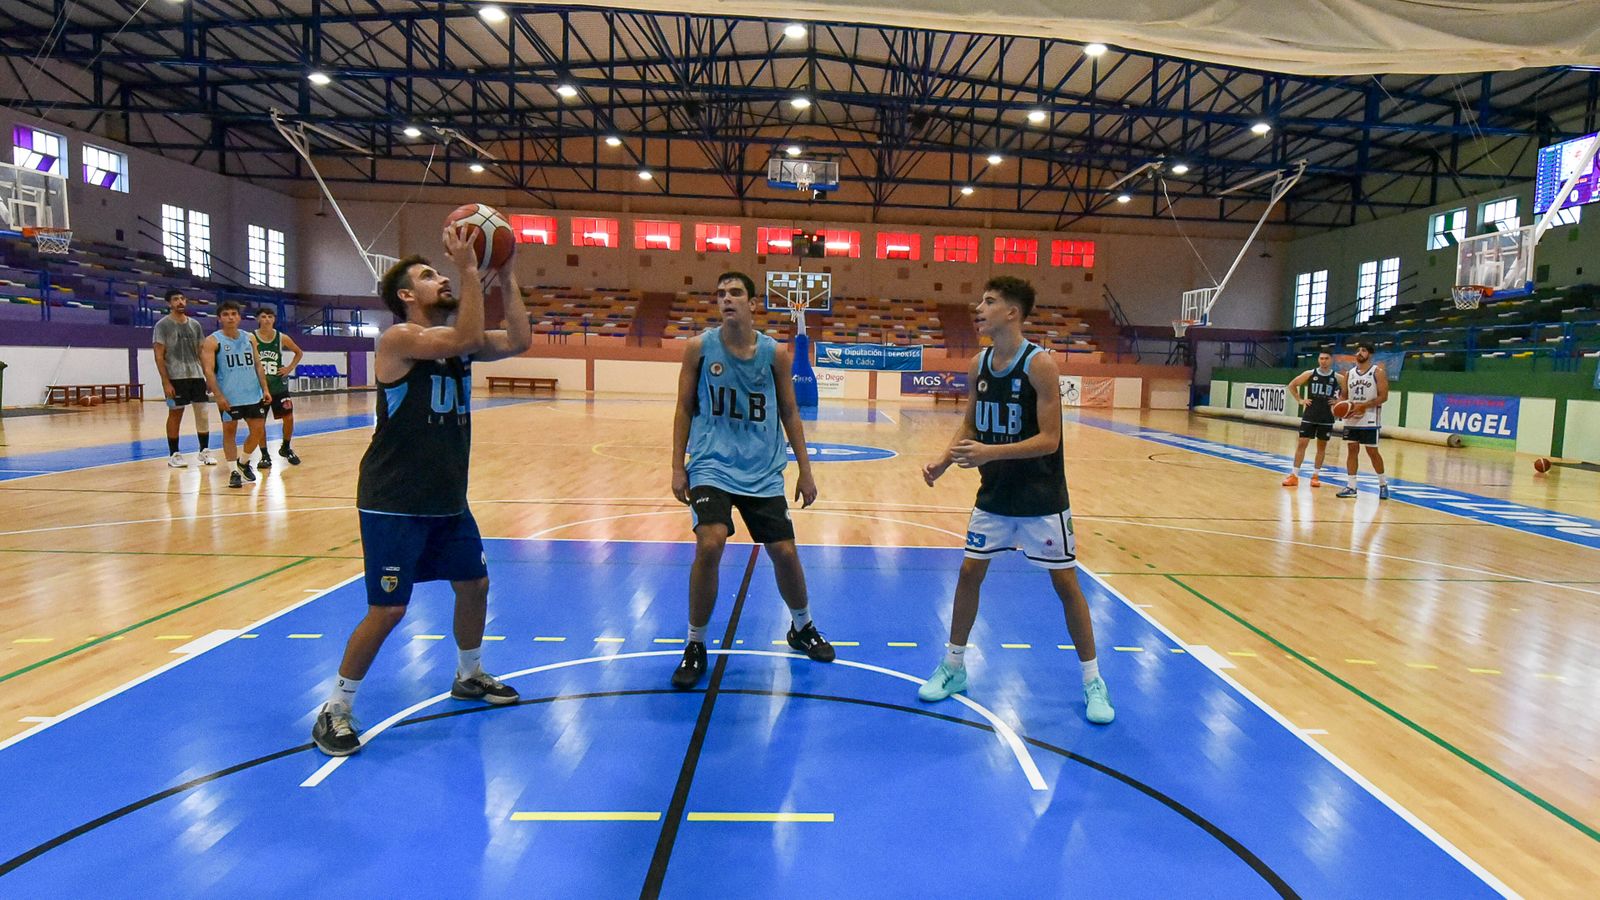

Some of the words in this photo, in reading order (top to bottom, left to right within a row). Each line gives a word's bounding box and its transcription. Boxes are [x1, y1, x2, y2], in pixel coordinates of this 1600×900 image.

[844, 348, 882, 357] Diputación
[888, 351, 920, 359] DEPORTES
[226, 353, 253, 368] ULB
[856, 357, 875, 366] Cádiz
[913, 376, 941, 386] MGS
[1311, 383, 1333, 396] ULB
[1354, 386, 1364, 395] 41
[709, 384, 767, 422] ULB
[1260, 388, 1285, 412] STROG
[975, 400, 1023, 435] ULB
[1436, 406, 1511, 435] ÁNGEL
